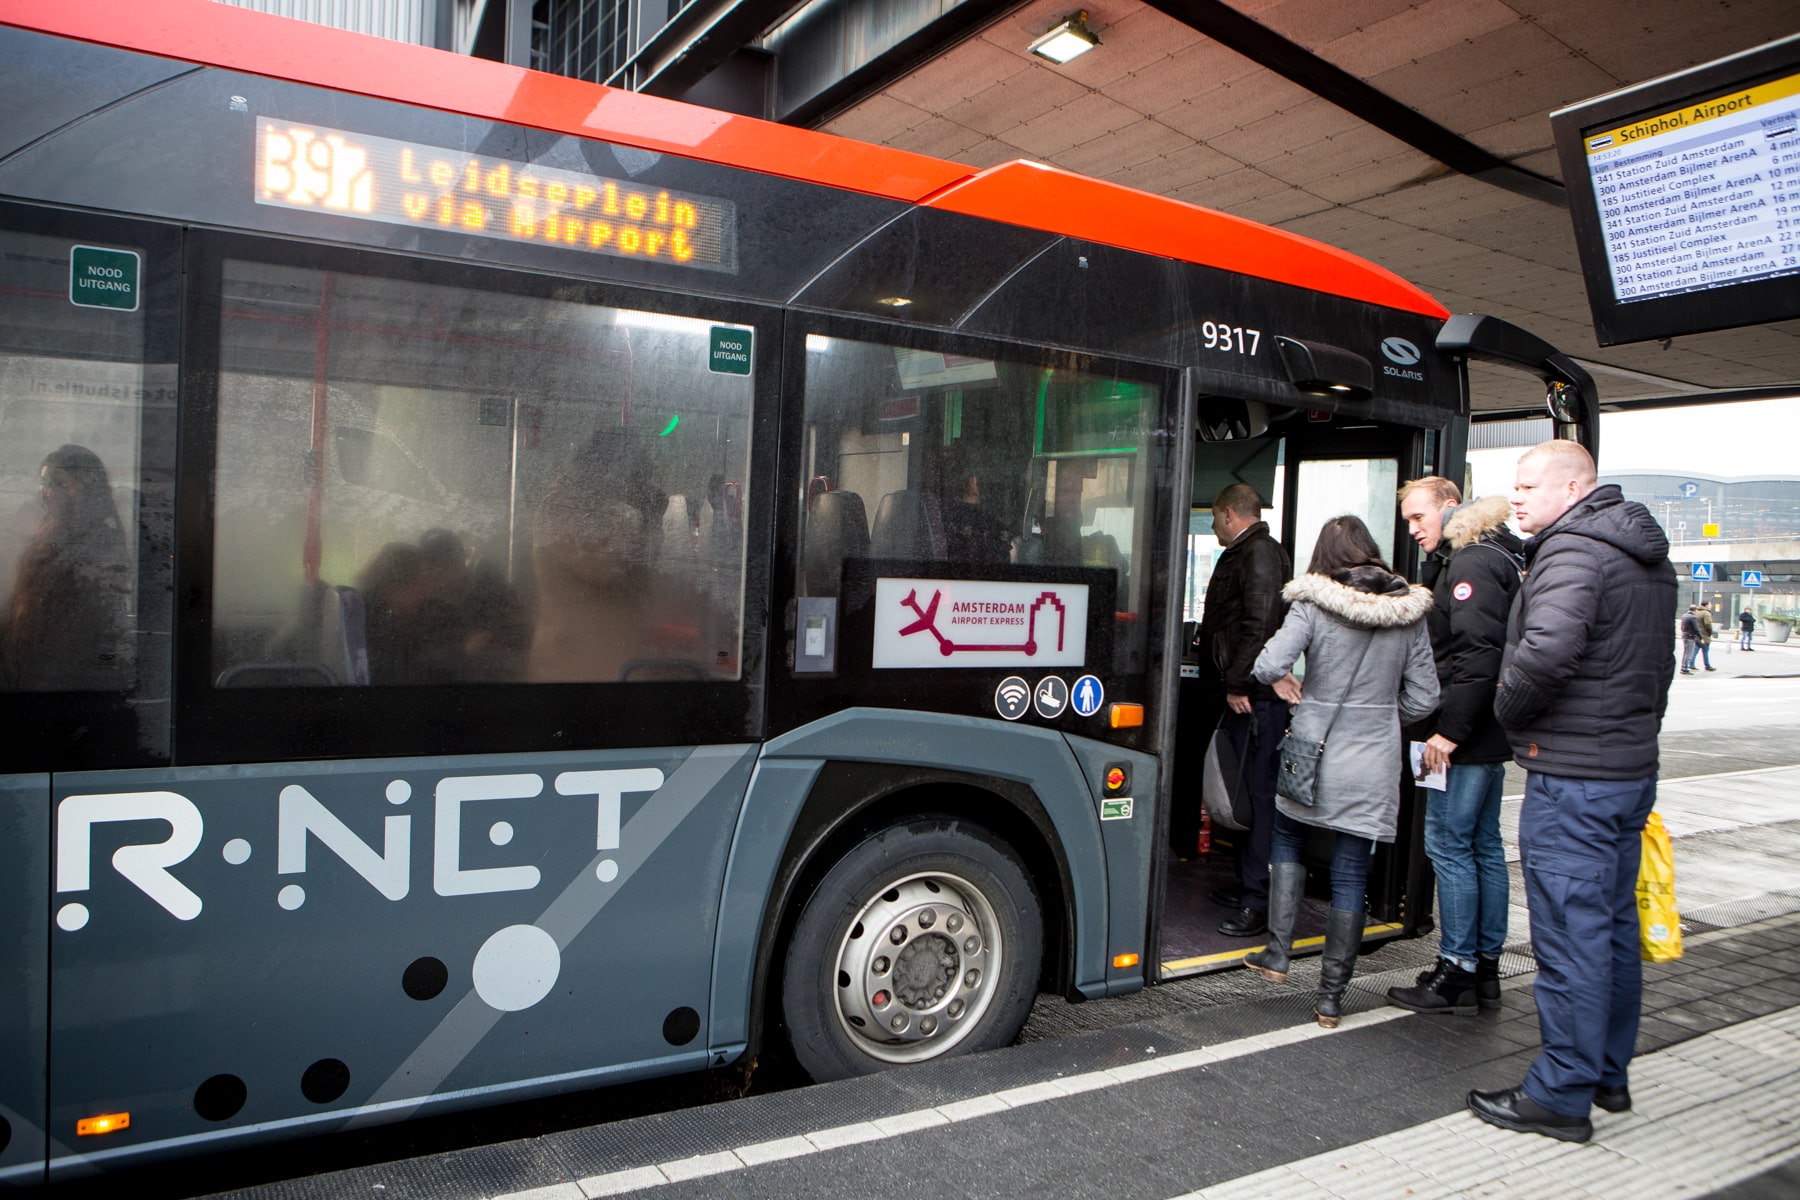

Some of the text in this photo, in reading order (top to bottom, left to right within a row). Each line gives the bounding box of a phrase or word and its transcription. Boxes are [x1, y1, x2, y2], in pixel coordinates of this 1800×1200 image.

[1620, 94, 1752, 142] Schiphol, Airport
[1594, 111, 1797, 173] Lijn Bestemming Vertrek
[1597, 139, 1744, 184] 341 Station Zuid Amsterdam
[401, 148, 697, 226] Leidseplein
[1599, 184, 1616, 196] 300
[1618, 170, 1676, 191] Amsterdam
[1679, 159, 1717, 175] Bijlmer
[1721, 148, 1757, 164] ArenA
[1770, 142, 1777, 151] 4
[1602, 196, 1618, 206] 185
[1621, 183, 1665, 203] Justitieel
[1668, 173, 1715, 190] Complex
[1772, 155, 1779, 164] 6
[1603, 207, 1620, 218] 300
[1623, 194, 1681, 214] Amsterdam
[1683, 184, 1722, 199] Bijlmer
[1725, 173, 1762, 189] ArenA
[1768, 168, 1781, 178] 10
[1606, 219, 1622, 230] 341
[1625, 211, 1661, 225] Station
[1663, 203, 1687, 216] Zuid
[1690, 190, 1753, 210] Amsterdam
[1770, 181, 1783, 191] 12
[404, 194, 693, 262] via Airport
[1608, 230, 1625, 241] 300
[1628, 218, 1685, 236] Amsterdam
[1688, 208, 1726, 223] Bijlmer
[1730, 198, 1766, 213] ArenA
[1772, 193, 1786, 203] 16
[1611, 241, 1627, 252] 341
[1629, 234, 1665, 248] Station
[1668, 227, 1691, 239] Zuid
[1695, 214, 1758, 234] Amsterdam
[1775, 206, 1788, 215] 19
[1614, 252, 1630, 263] 185
[1632, 242, 1677, 259] Justitieel
[1679, 234, 1726, 249] Complex
[1776, 218, 1789, 229] 21
[1615, 264, 1632, 274] 300
[1635, 253, 1692, 270] Amsterdam
[1695, 245, 1733, 258] Bijlmer
[1737, 235, 1773, 249] ArenA
[1779, 231, 1792, 241] 22
[79, 278, 131, 293] UITGANG
[88, 265, 123, 279] NOOD
[1617, 243, 1794, 286] 341 Station Zuid Amsterdam 27
[1620, 286, 1636, 296] 300
[1639, 276, 1697, 293] Amsterdam
[1699, 269, 1737, 282] Bijlmer
[1741, 260, 1777, 274] ArenA
[1783, 256, 1796, 266] 28
[714, 351, 747, 361] UITGANG
[720, 341, 742, 350] NOOD
[1202, 321, 1261, 356] 9317
[1383, 366, 1424, 381] SOLARIS
[951, 616, 1025, 626] AIRPORT EXPRESS
[952, 602, 1025, 614] AMSTERDAM
